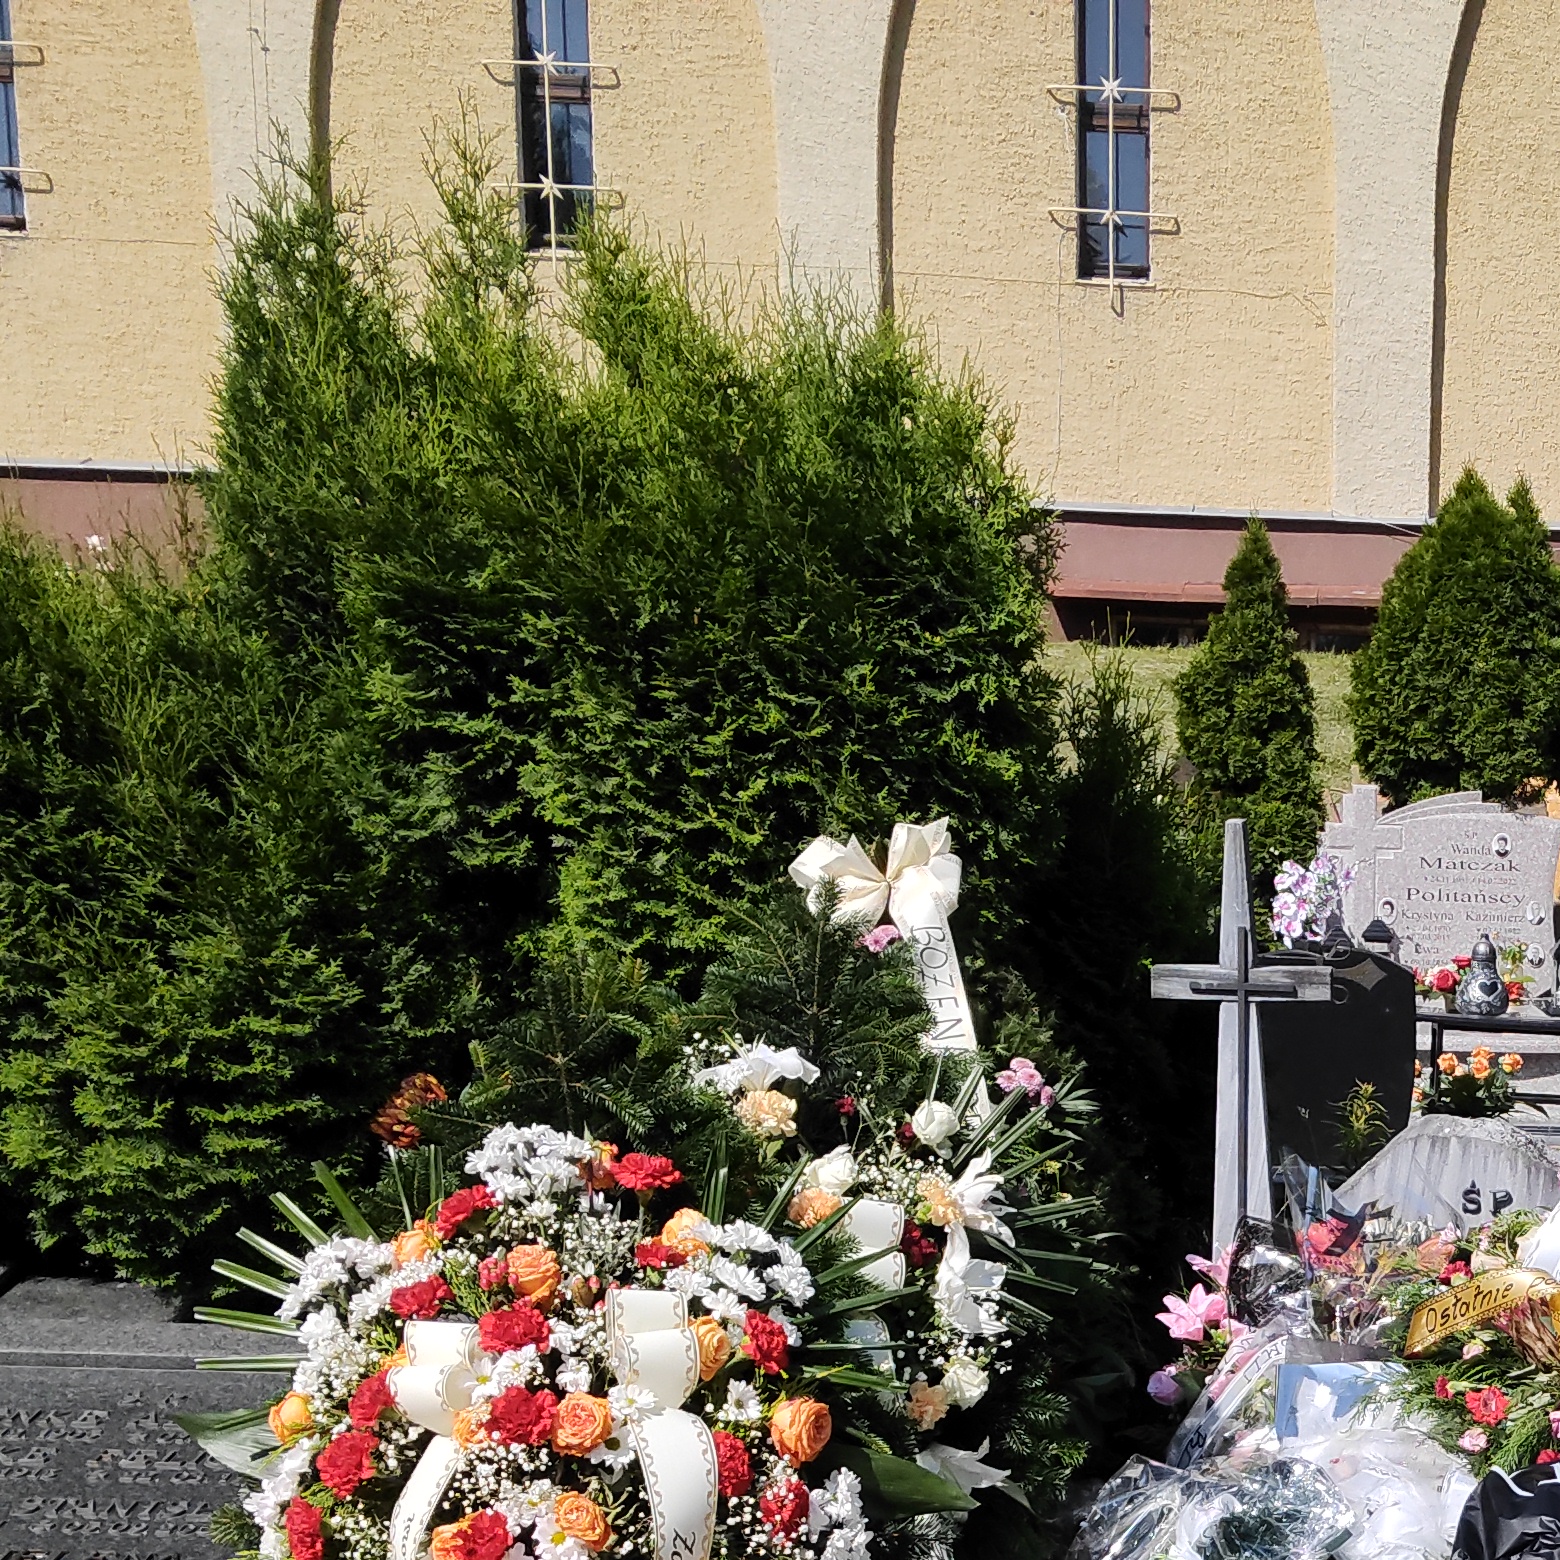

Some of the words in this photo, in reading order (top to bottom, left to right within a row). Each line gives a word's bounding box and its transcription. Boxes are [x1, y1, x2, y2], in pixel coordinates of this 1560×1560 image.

[1451, 842, 1491, 856] Wanda
[1419, 856, 1521, 872] Matczak
[1406, 887, 1526, 908] Politańscy
[1425, 1279, 1514, 1333] Ostatnie
